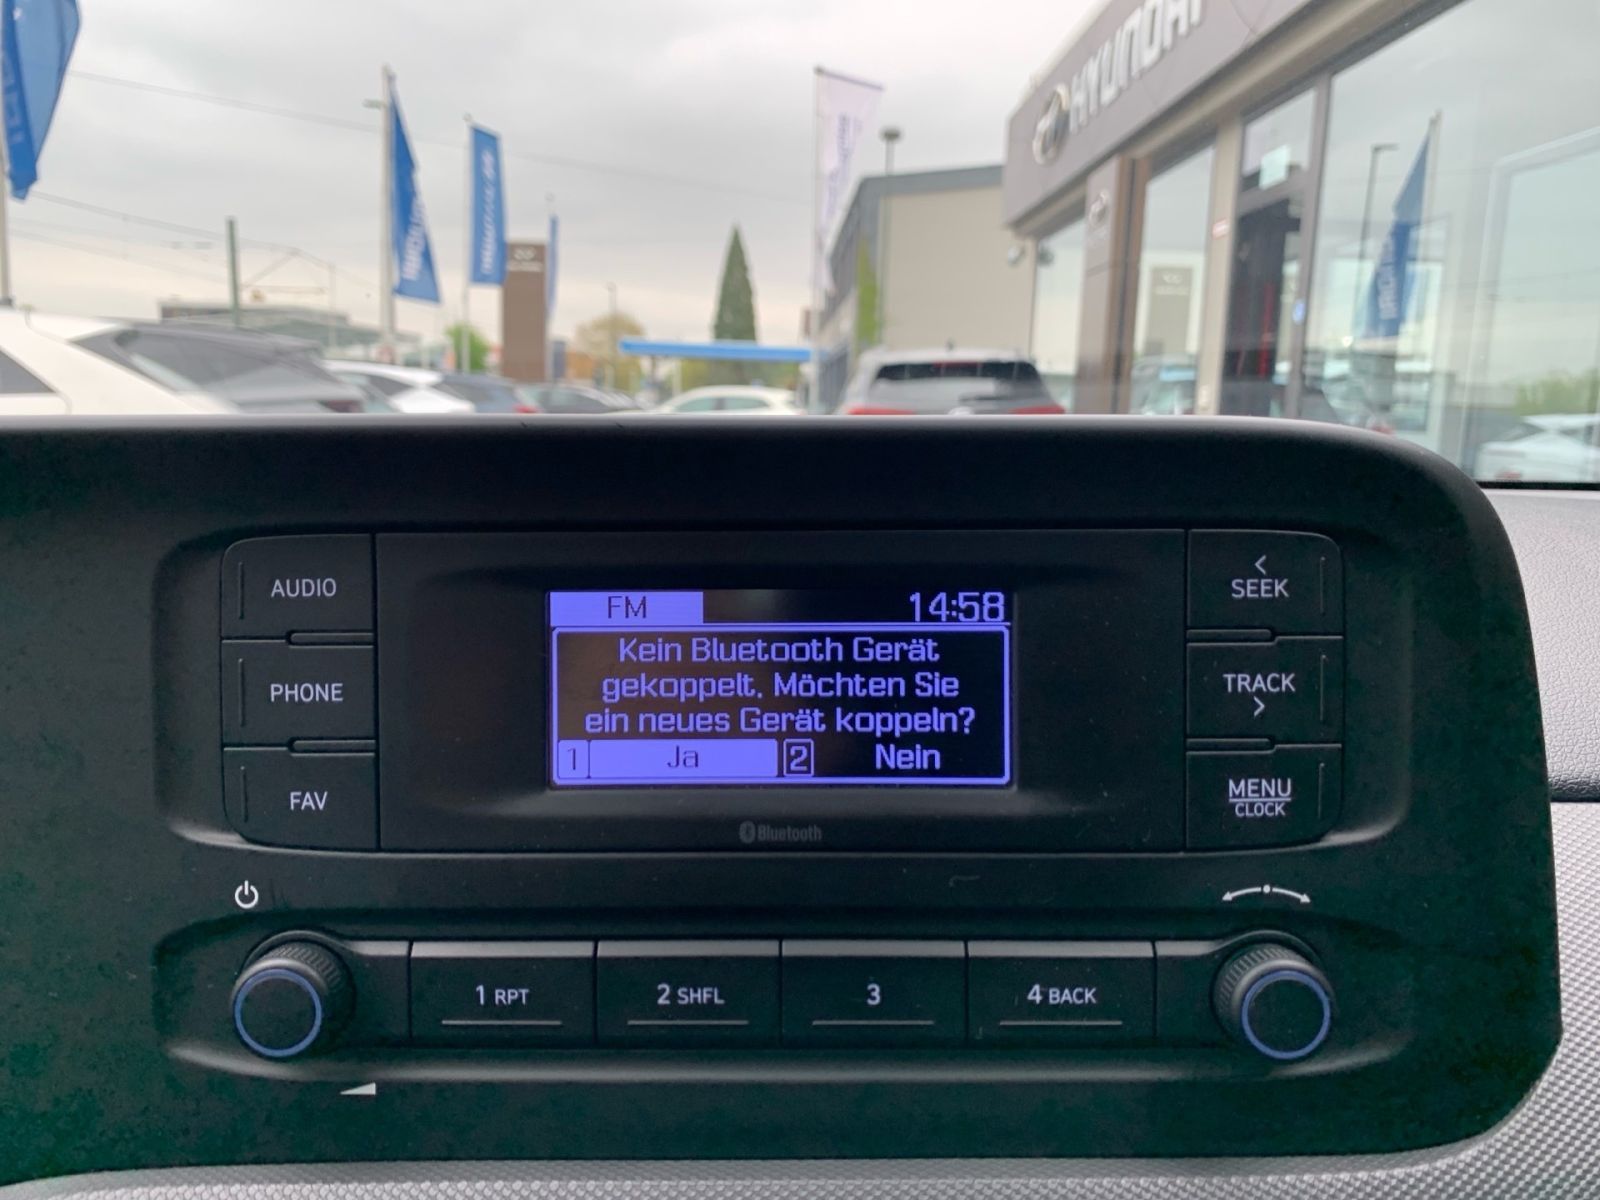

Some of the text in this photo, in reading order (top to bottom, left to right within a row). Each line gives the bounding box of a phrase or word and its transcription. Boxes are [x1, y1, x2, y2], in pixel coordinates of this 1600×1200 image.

[271, 577, 337, 598] AUDIO
[1231, 578, 1289, 598] SEEK
[607, 596, 647, 619] FM
[909, 592, 1005, 622] 14:58
[618, 637, 939, 662] Kein Bluetooth Gerät
[270, 683, 343, 702] PHONE
[602, 672, 959, 703] gekoppelt. Möchten Sie
[1223, 673, 1295, 692] TRACK
[585, 707, 975, 737] ein neues Gerät koppeln?
[567, 746, 699, 771] 1 Ja
[790, 744, 941, 772] 2 Nein
[1228, 778, 1292, 798] MENU
[290, 791, 328, 810] FAV
[1235, 802, 1285, 817] CLOCK
[757, 824, 822, 842] Bluetooth
[475, 984, 529, 1005] 1 RPT
[657, 983, 725, 1005] 2 SHFL
[867, 983, 881, 1005] 3
[1027, 984, 1097, 1005] 4 BACK
